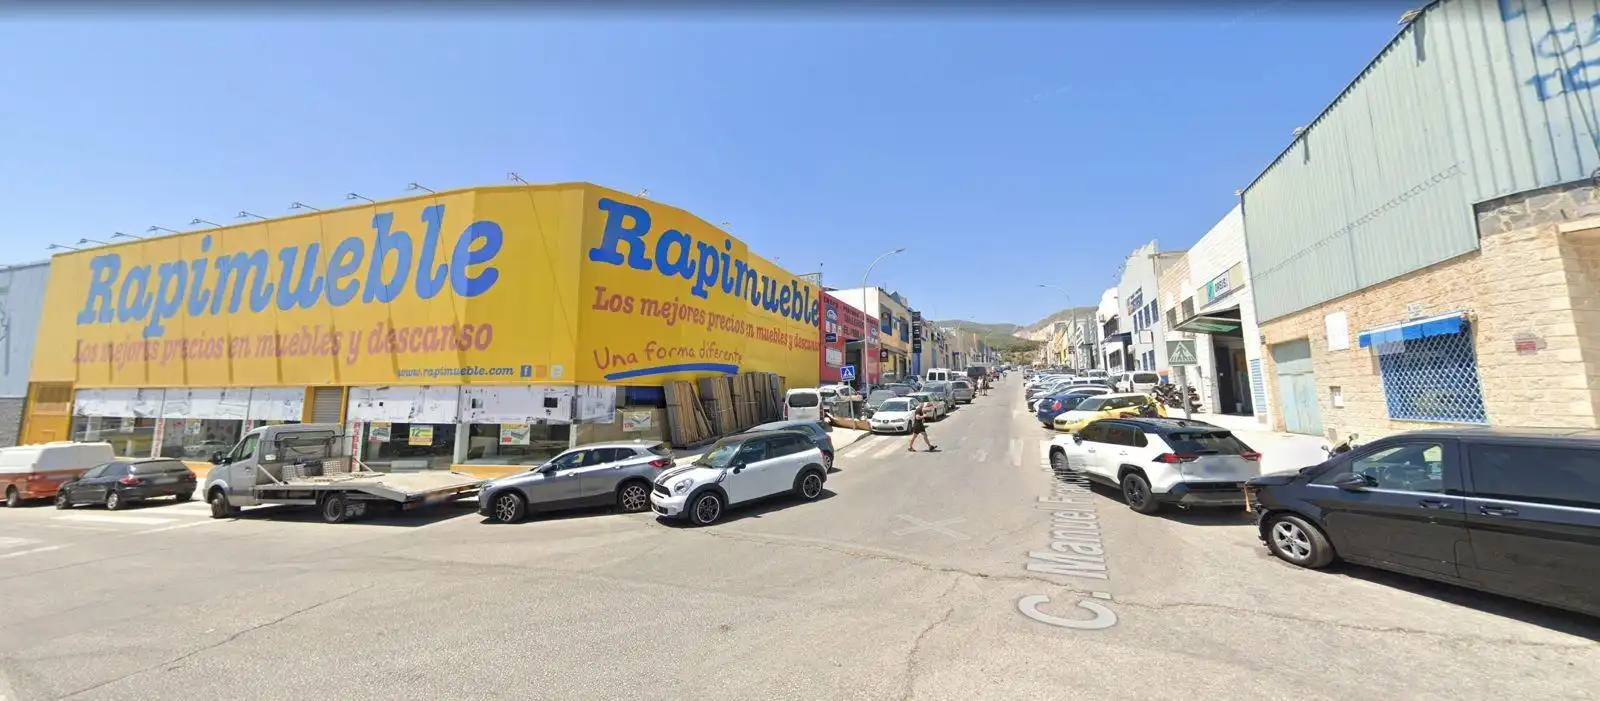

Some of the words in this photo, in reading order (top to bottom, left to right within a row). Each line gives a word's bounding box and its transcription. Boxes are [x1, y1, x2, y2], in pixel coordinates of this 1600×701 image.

[76, 204, 503, 338] Rapimueble
[589, 197, 820, 327] Rapimueble
[592, 286, 634, 314] Los
[640, 296, 706, 327] mejores
[708, 311, 745, 336] precios
[756, 325, 788, 347] muebles
[73, 339, 97, 364] Los
[99, 334, 160, 372] mejores
[160, 329, 225, 366] precios
[227, 334, 251, 359] en
[255, 324, 344, 358] muebles
[346, 328, 363, 366] y
[367, 321, 494, 355] descanso
[397, 365, 515, 379] www.rapimueble.com
[593, 346, 639, 370] Una
[644, 340, 696, 361] forma
[699, 340, 743, 363] diferente
